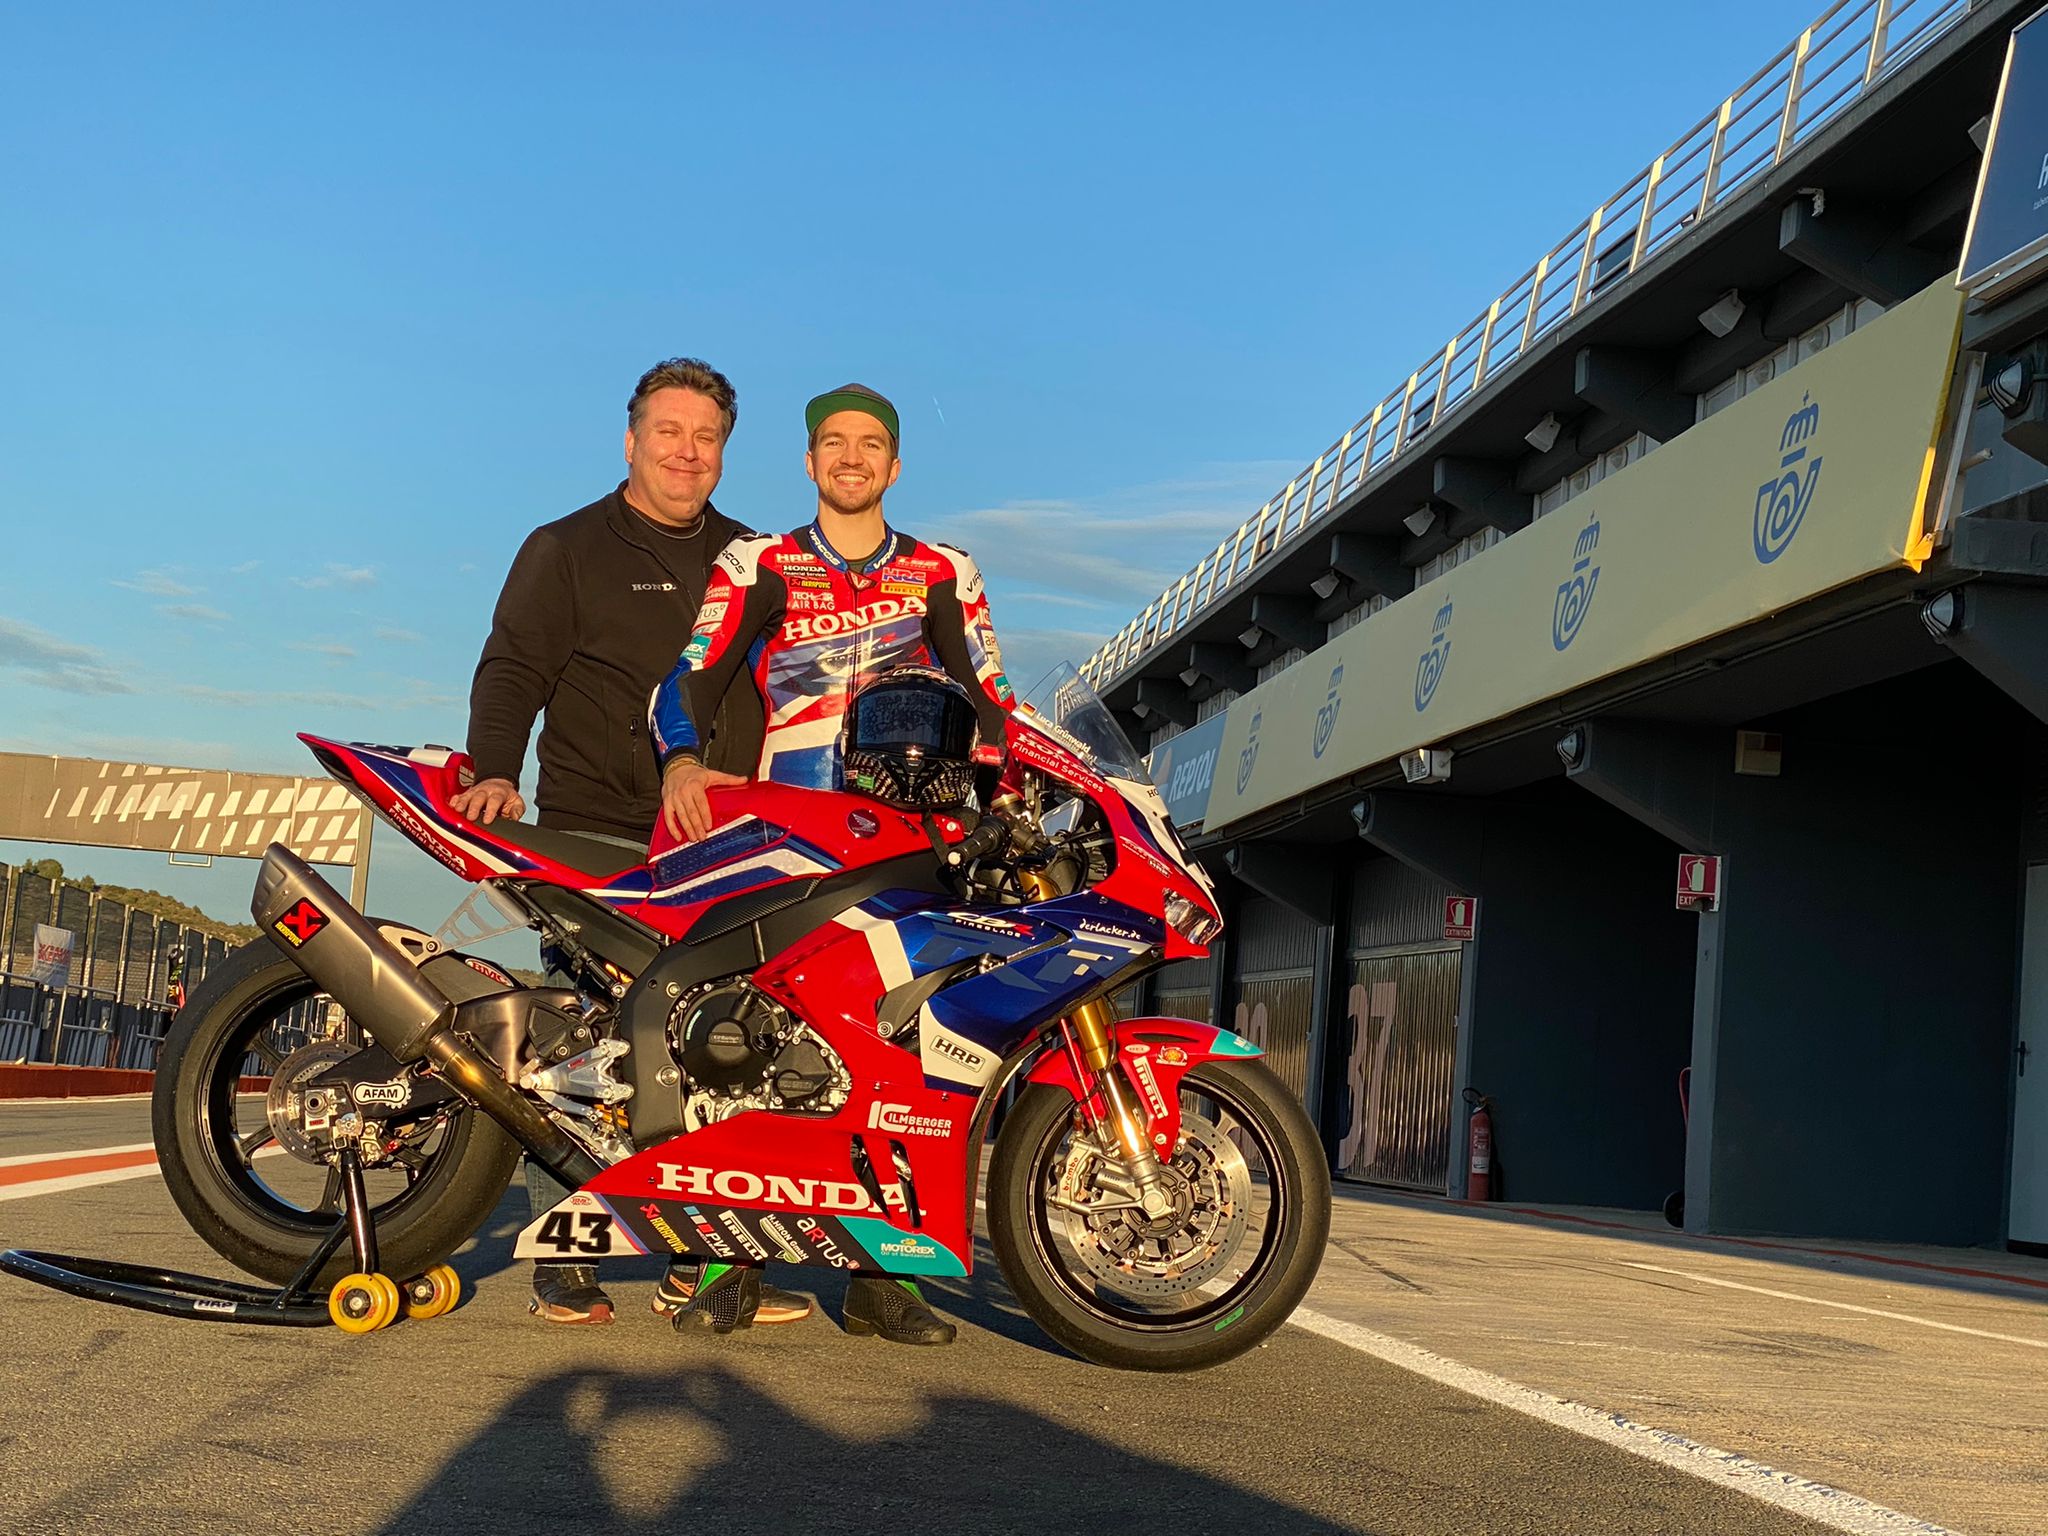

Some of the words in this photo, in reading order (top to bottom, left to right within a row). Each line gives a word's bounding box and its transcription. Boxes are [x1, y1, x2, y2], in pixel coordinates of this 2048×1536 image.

[775, 552, 817, 564] HRP
[808, 527, 841, 566] VIRCOS
[873, 533, 898, 570] VIRCOS
[783, 564, 826, 573] HONDA
[882, 567, 926, 584] HRC
[782, 595, 928, 642] HONDA
[791, 600, 811, 609] AIR
[813, 601, 836, 611] BAG
[1036, 711, 1055, 728] Luca
[1053, 724, 1092, 753] Grünwald
[1011, 741, 1060, 769] Financial
[1060, 764, 1105, 794] Services
[1168, 748, 1217, 804] REPSOL
[388, 807, 428, 844] Financial
[427, 842, 467, 877] Services
[392, 800, 468, 872] HONDA
[955, 918, 1021, 938] FIREBLADE
[1079, 918, 1141, 940] derlacker.de
[935, 1038, 981, 1065] HRP
[362, 1088, 399, 1100] AFAM
[1132, 1055, 1169, 1120] PIRELLI
[1339, 981, 1398, 1170] 37
[656, 1162, 927, 1217] HONDA
[1062, 1156, 1079, 1192] brembo
[535, 1210, 613, 1255] 43
[705, 1232, 736, 1258] PVM
[718, 1209, 769, 1262] PIRELLI
[766, 1213, 792, 1243] H.HRON
[789, 1239, 810, 1261] GmbH
[796, 1216, 850, 1269] aRTUS
[880, 1242, 936, 1256] MOTOREX
